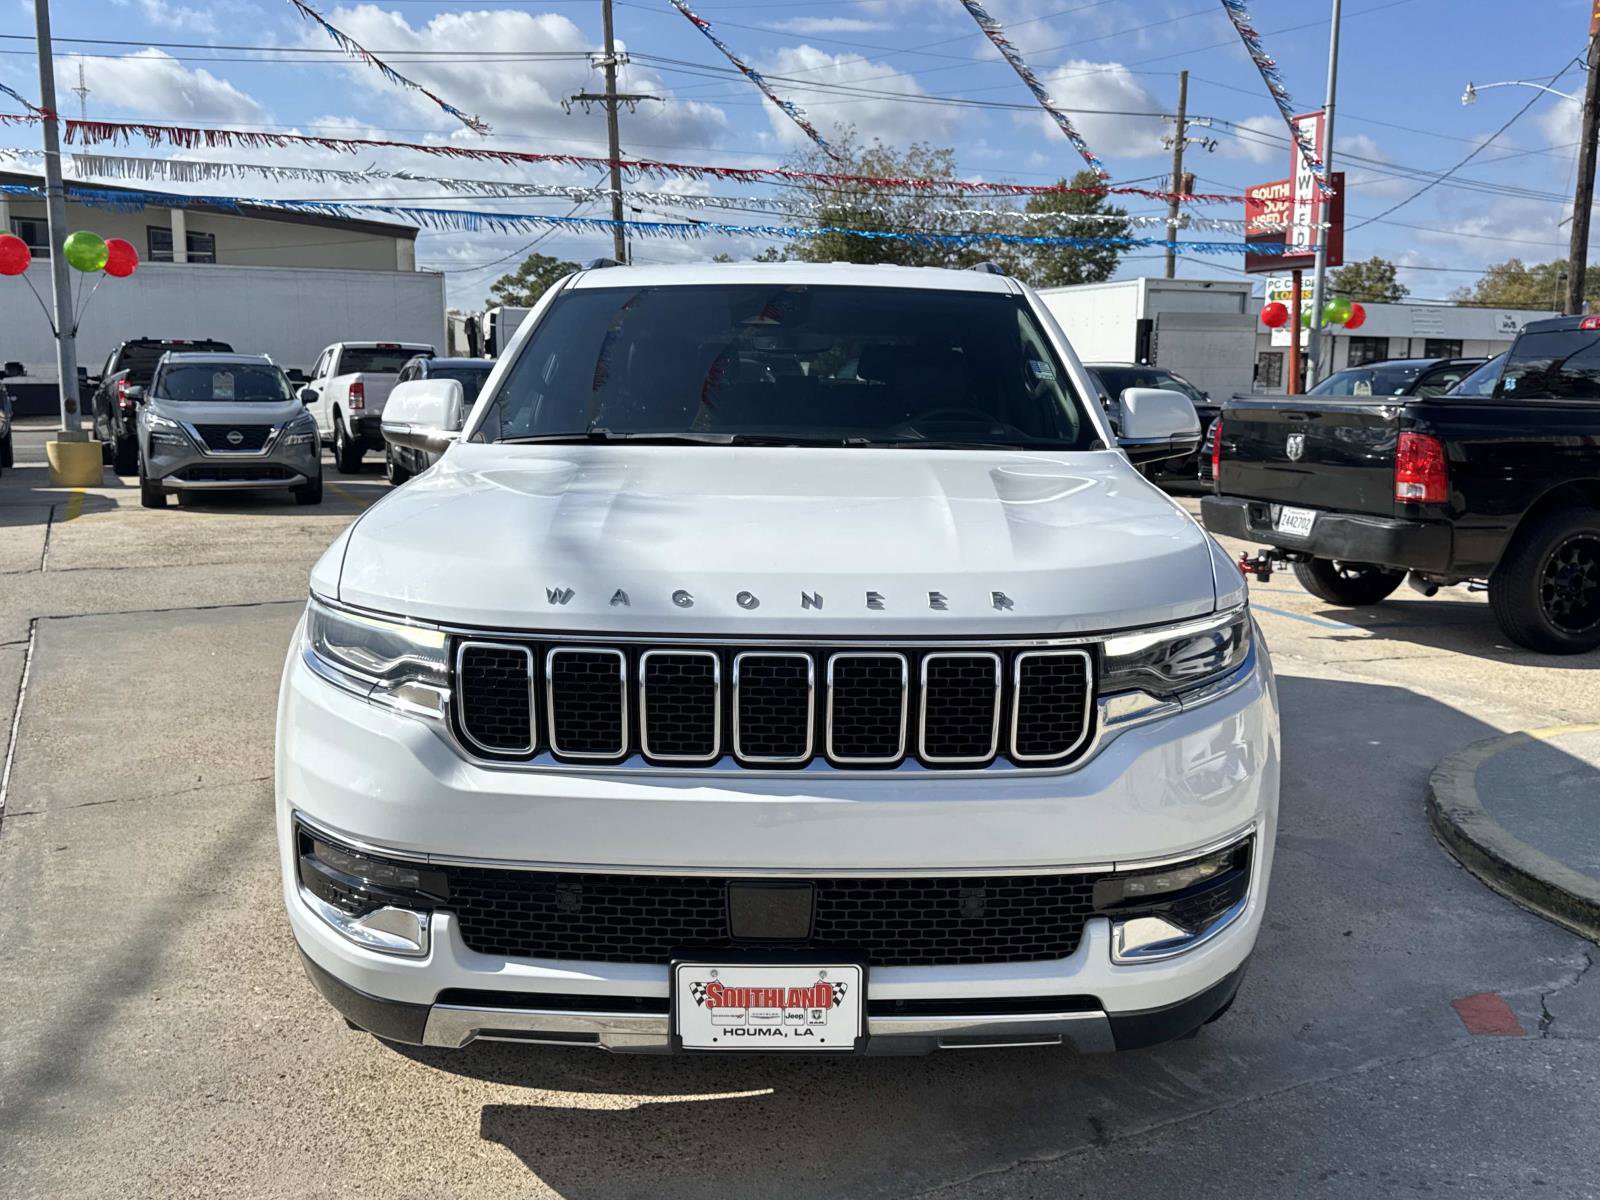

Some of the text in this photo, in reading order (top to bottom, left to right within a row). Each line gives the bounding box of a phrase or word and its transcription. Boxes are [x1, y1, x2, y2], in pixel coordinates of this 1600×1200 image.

[546, 587, 1014, 610] WAGONEER
[706, 982, 833, 1009] SOUTHLAND
[785, 1012, 804, 1020] Jeep
[723, 1028, 814, 1037] HOUMA, LA
